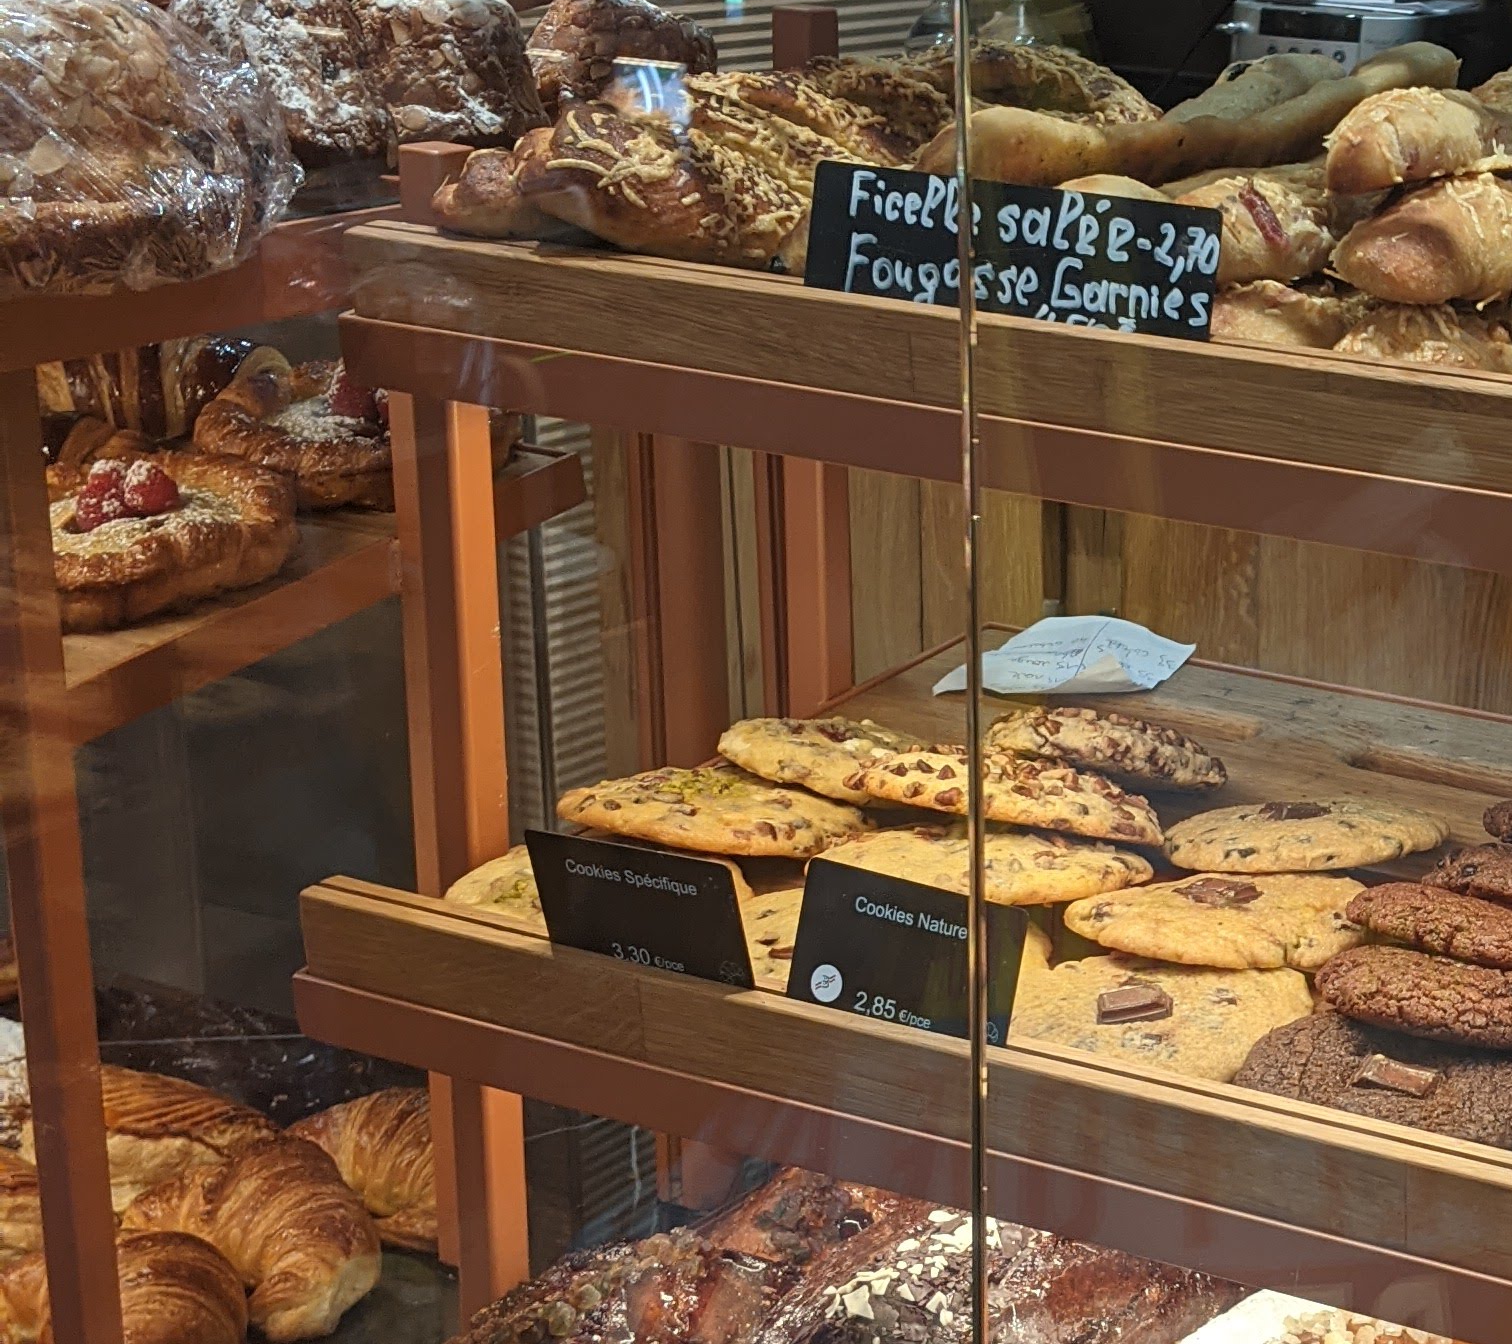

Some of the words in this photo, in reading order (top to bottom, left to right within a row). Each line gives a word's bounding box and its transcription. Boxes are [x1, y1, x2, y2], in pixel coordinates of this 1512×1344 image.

[565, 858, 621, 885] Cookies
[624, 868, 698, 898] Spécifique
[855, 895, 914, 927] Cookies
[918, 910, 968, 941] Nature
[853, 991, 897, 1021] 2,85
[899, 1007, 931, 1030] €/pce
